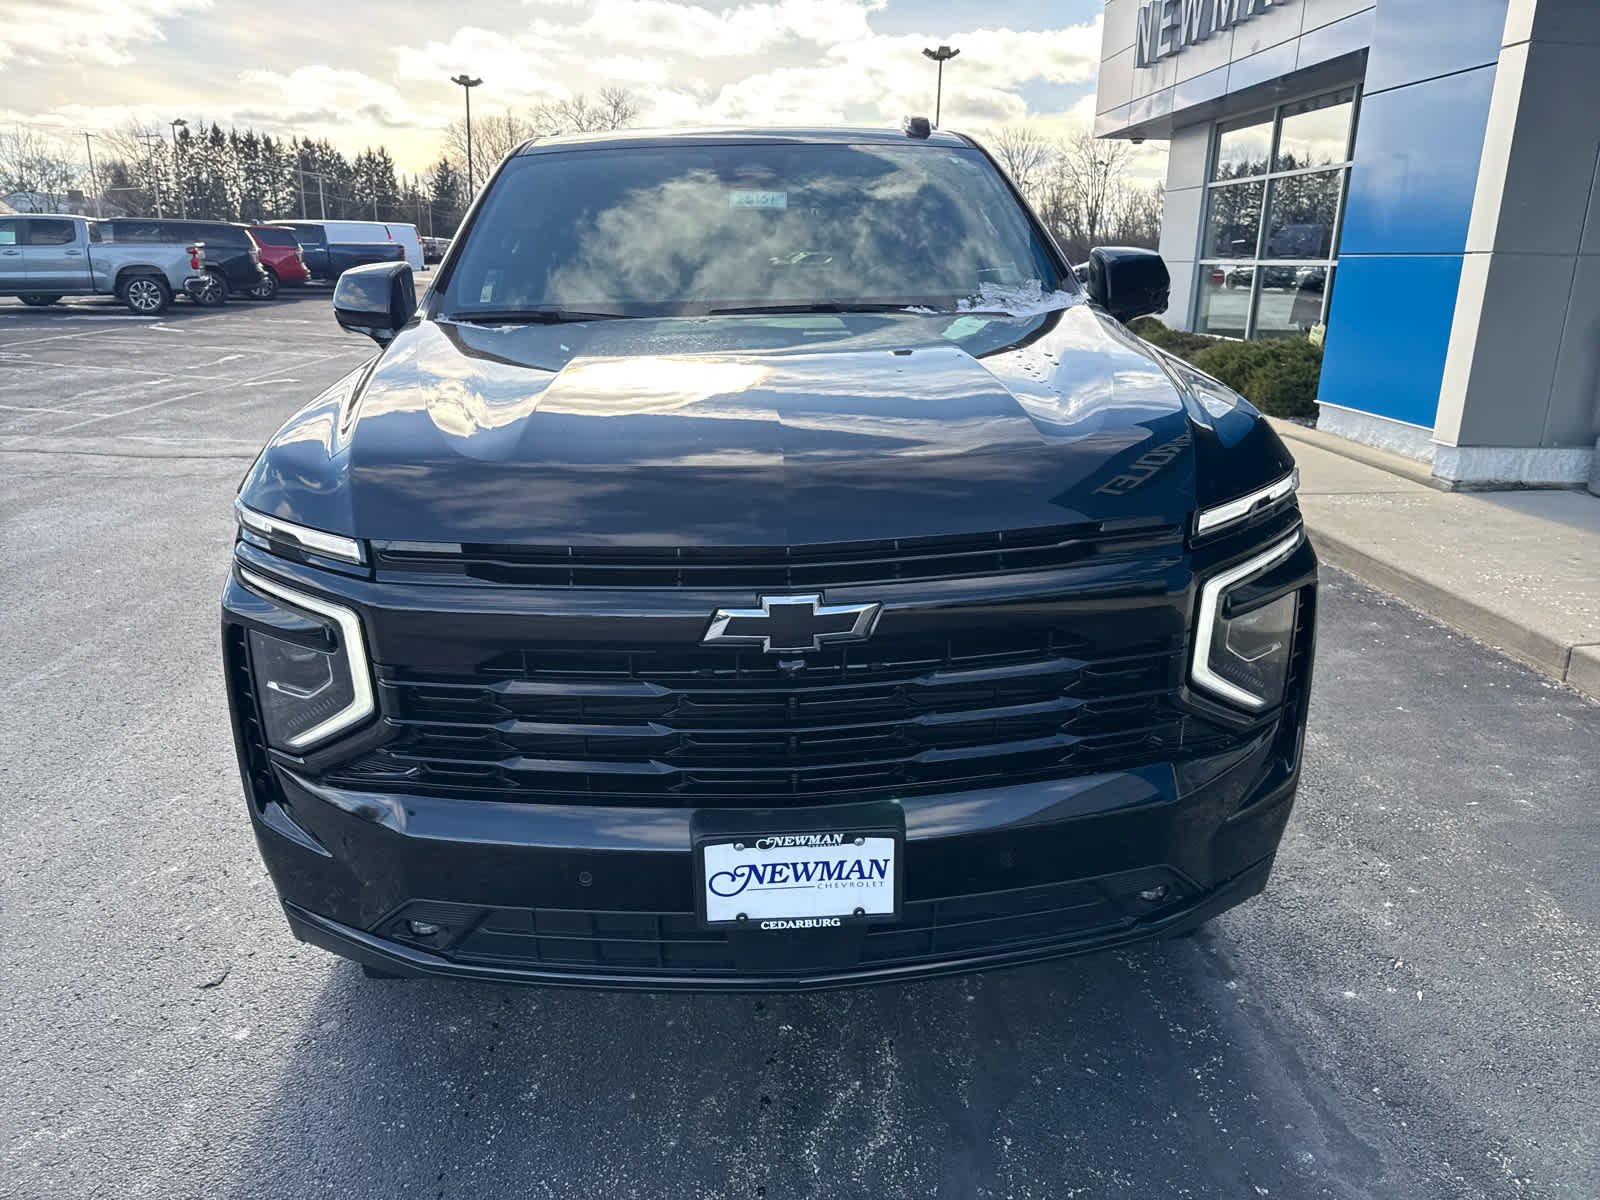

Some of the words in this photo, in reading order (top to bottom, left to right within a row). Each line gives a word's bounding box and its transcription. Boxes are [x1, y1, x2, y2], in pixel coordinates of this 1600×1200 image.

[756, 834, 844, 850] NEWMAN
[708, 859, 890, 897] NEWMAN
[817, 881, 885, 889] CHEVROLET
[761, 918, 841, 930] CEDARBURG
